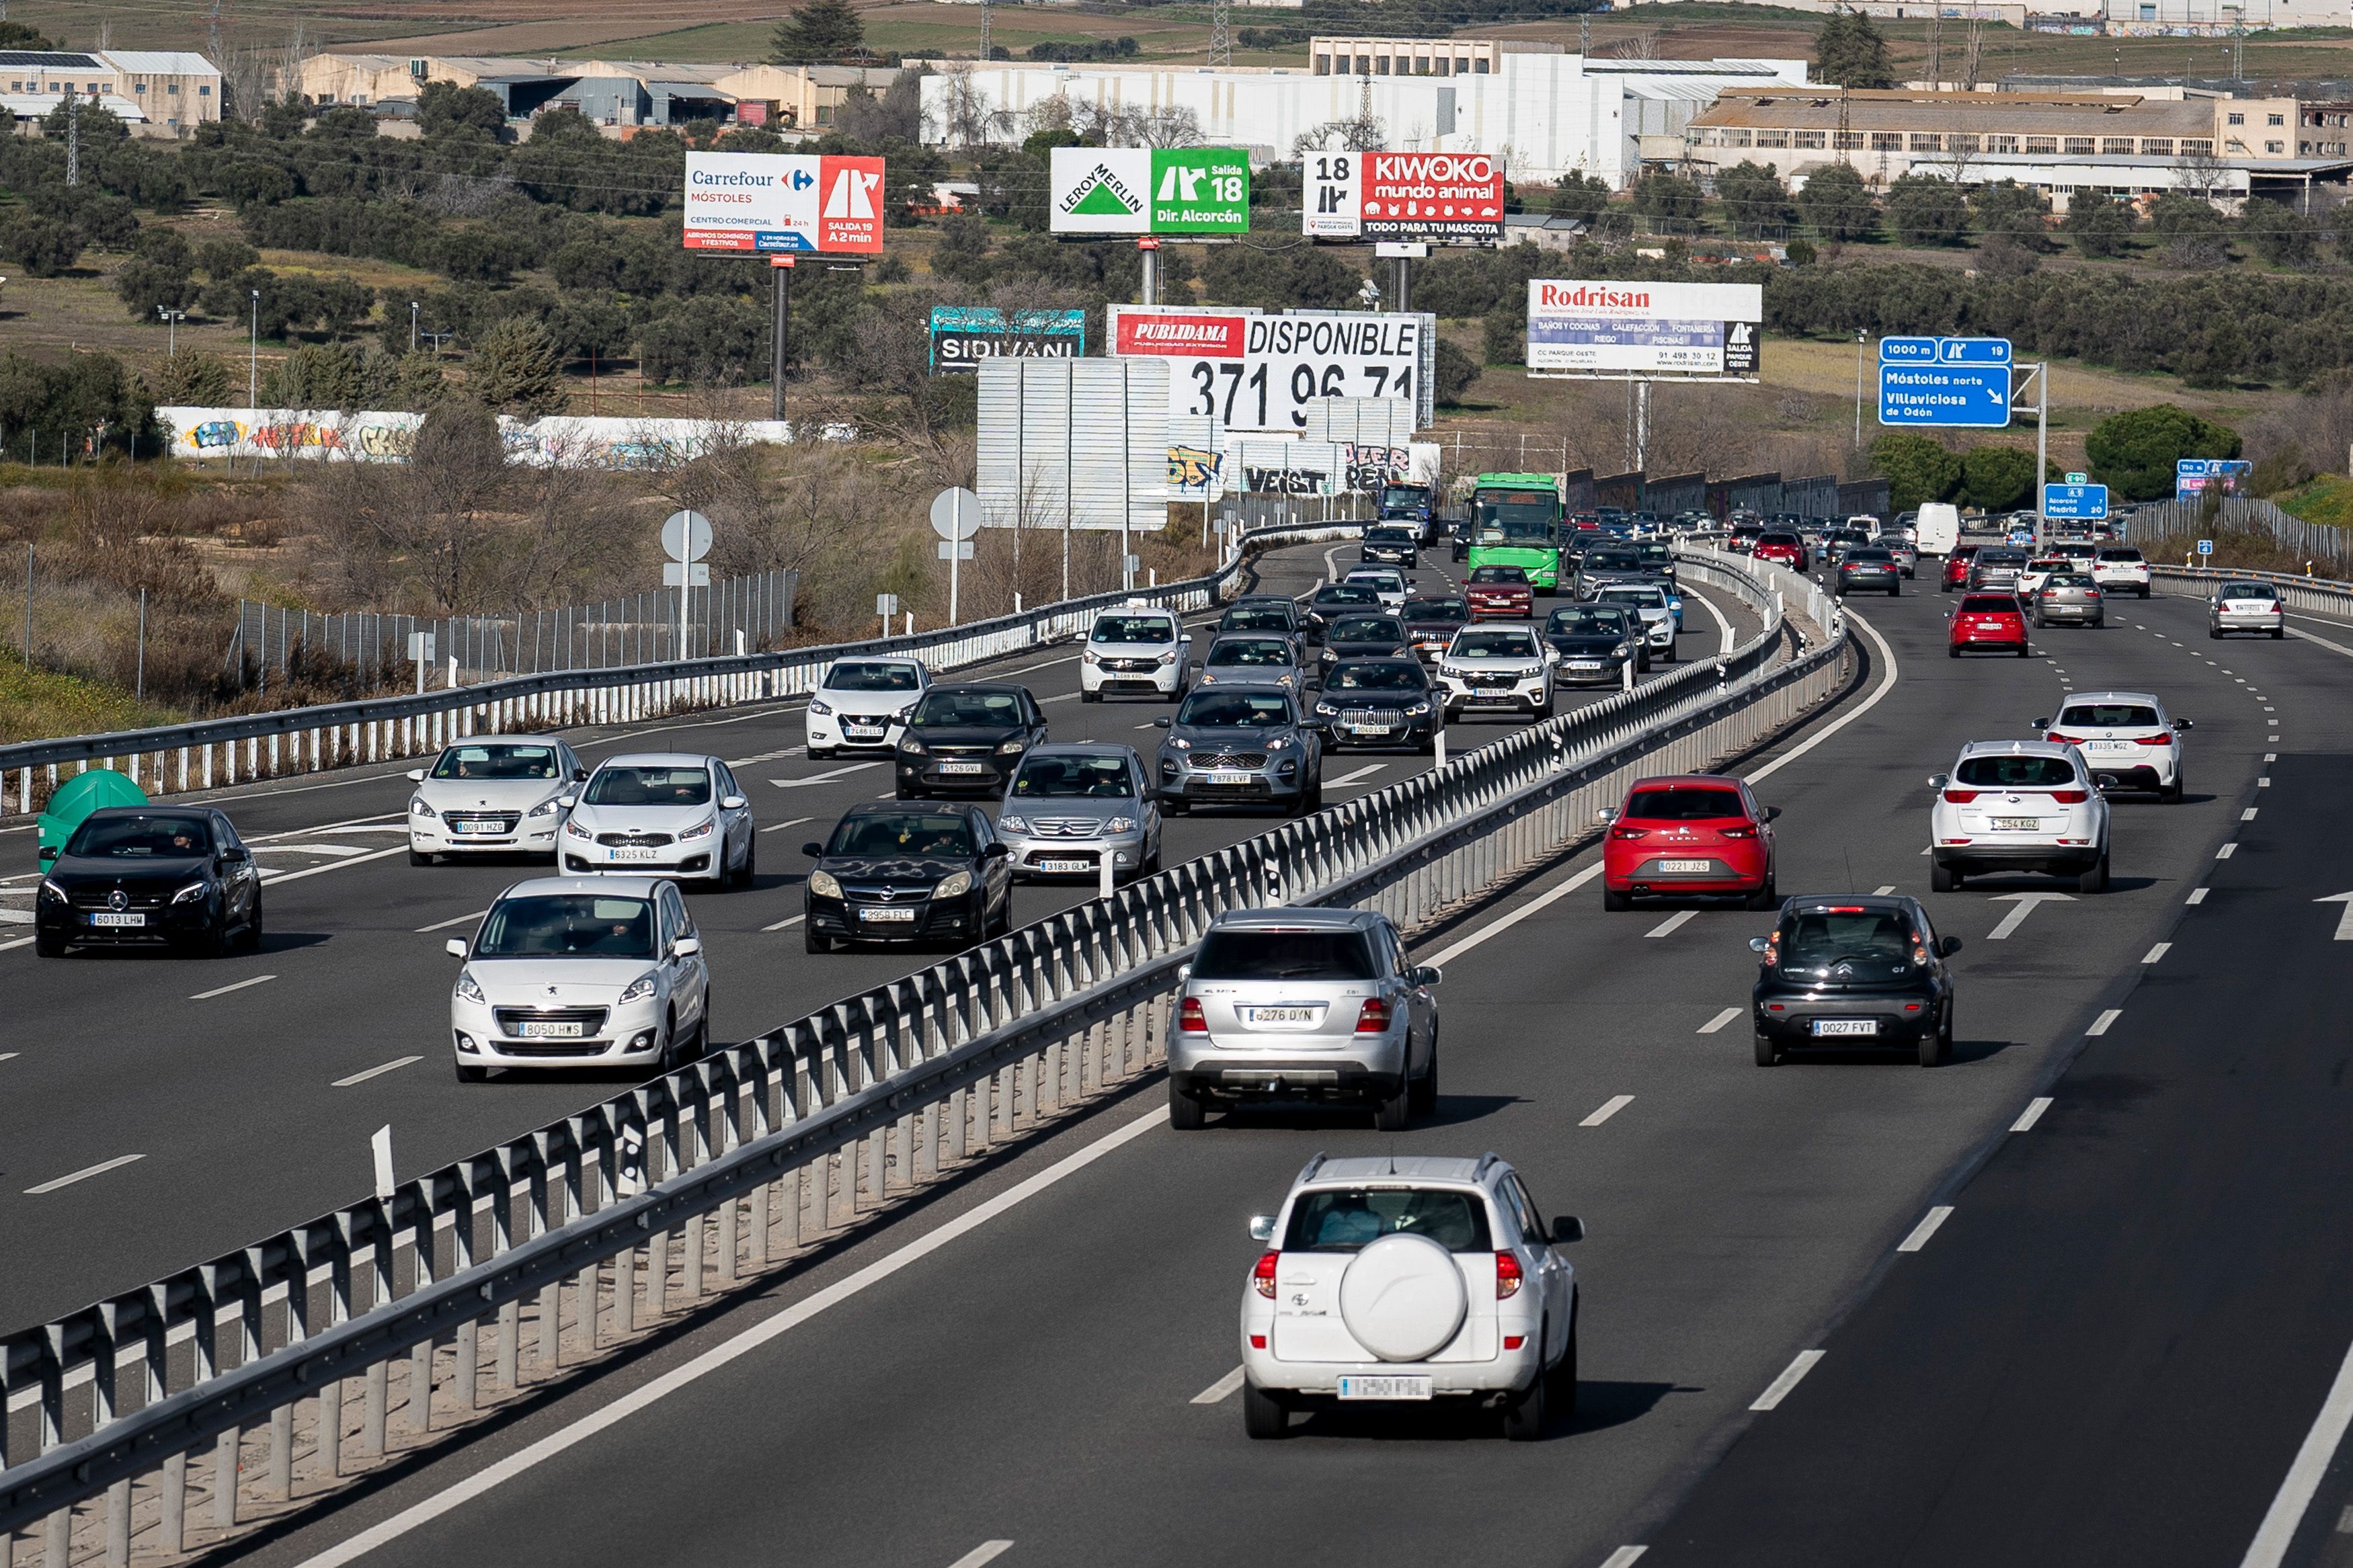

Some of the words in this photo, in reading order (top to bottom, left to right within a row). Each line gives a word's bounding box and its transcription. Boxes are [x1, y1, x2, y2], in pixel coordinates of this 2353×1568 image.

[1211, 165, 1242, 175] Salida
[1316, 157, 1350, 181] 18
[1375, 156, 1493, 182] KIWOKO
[692, 170, 773, 186] Carrefour
[1060, 172, 1098, 212] LEROY
[1094, 163, 1143, 213] MERLIN
[1211, 177, 1243, 202] 18
[1375, 181, 1434, 199] mundo
[1438, 183, 1494, 200] animal
[691, 191, 752, 203] MÓSTOLES
[690, 216, 724, 224] CENTRO
[725, 218, 772, 226] COMERCIAL
[1157, 210, 1179, 222] Dir.
[1182, 210, 1242, 223] Alcorcón
[828, 222, 861, 231] SALIDA
[862, 222, 873, 231] 19
[1365, 222, 1397, 233] TODO
[1400, 222, 1427, 233] PARA
[1430, 222, 1444, 233] TU
[1449, 223, 1499, 235] MASCOTA
[706, 239, 738, 247] FESTIVOS
[828, 233, 838, 242] A
[840, 233, 847, 243] 2
[848, 233, 872, 243] min
[1542, 284, 1650, 307] Rodrisan
[1538, 321, 1563, 330] BAÑOS
[1569, 323, 1600, 331] COCINAS
[1134, 323, 1228, 341] PUBLIDAMA
[1248, 321, 1415, 356] DISPONIBLE
[1594, 335, 1616, 343] RIEGO
[1652, 336, 1684, 345] PISCINAS
[1888, 345, 1917, 354] 1000
[1991, 346, 2003, 356] 19
[1657, 359, 1718, 368] www.rodrisan.com
[1886, 372, 1949, 385] Móstoles
[1953, 376, 1983, 385] norte
[1190, 362, 1268, 426] 371
[1886, 393, 1966, 406] Villaviciosa
[1886, 407, 1899, 416] de
[1904, 407, 1932, 417] Odón
[2048, 505, 2077, 513] Madrid
[1213, 774, 1231, 782] 7878
[2020, 819, 2037, 828] KGZ
[640, 850, 657, 858] KLZ
[1048, 862, 1068, 870] 3183
[1072, 862, 1087, 870] GLM
[1691, 862, 1707, 870] JZS
[97, 915, 121, 924] 6013
[124, 915, 143, 925] LHM
[1289, 1009, 1312, 1020] DYN
[527, 1024, 555, 1034] 8050
[559, 1024, 580, 1034] HWS
[1823, 1023, 1848, 1032] 0027
[1852, 1023, 1872, 1032] FVT
